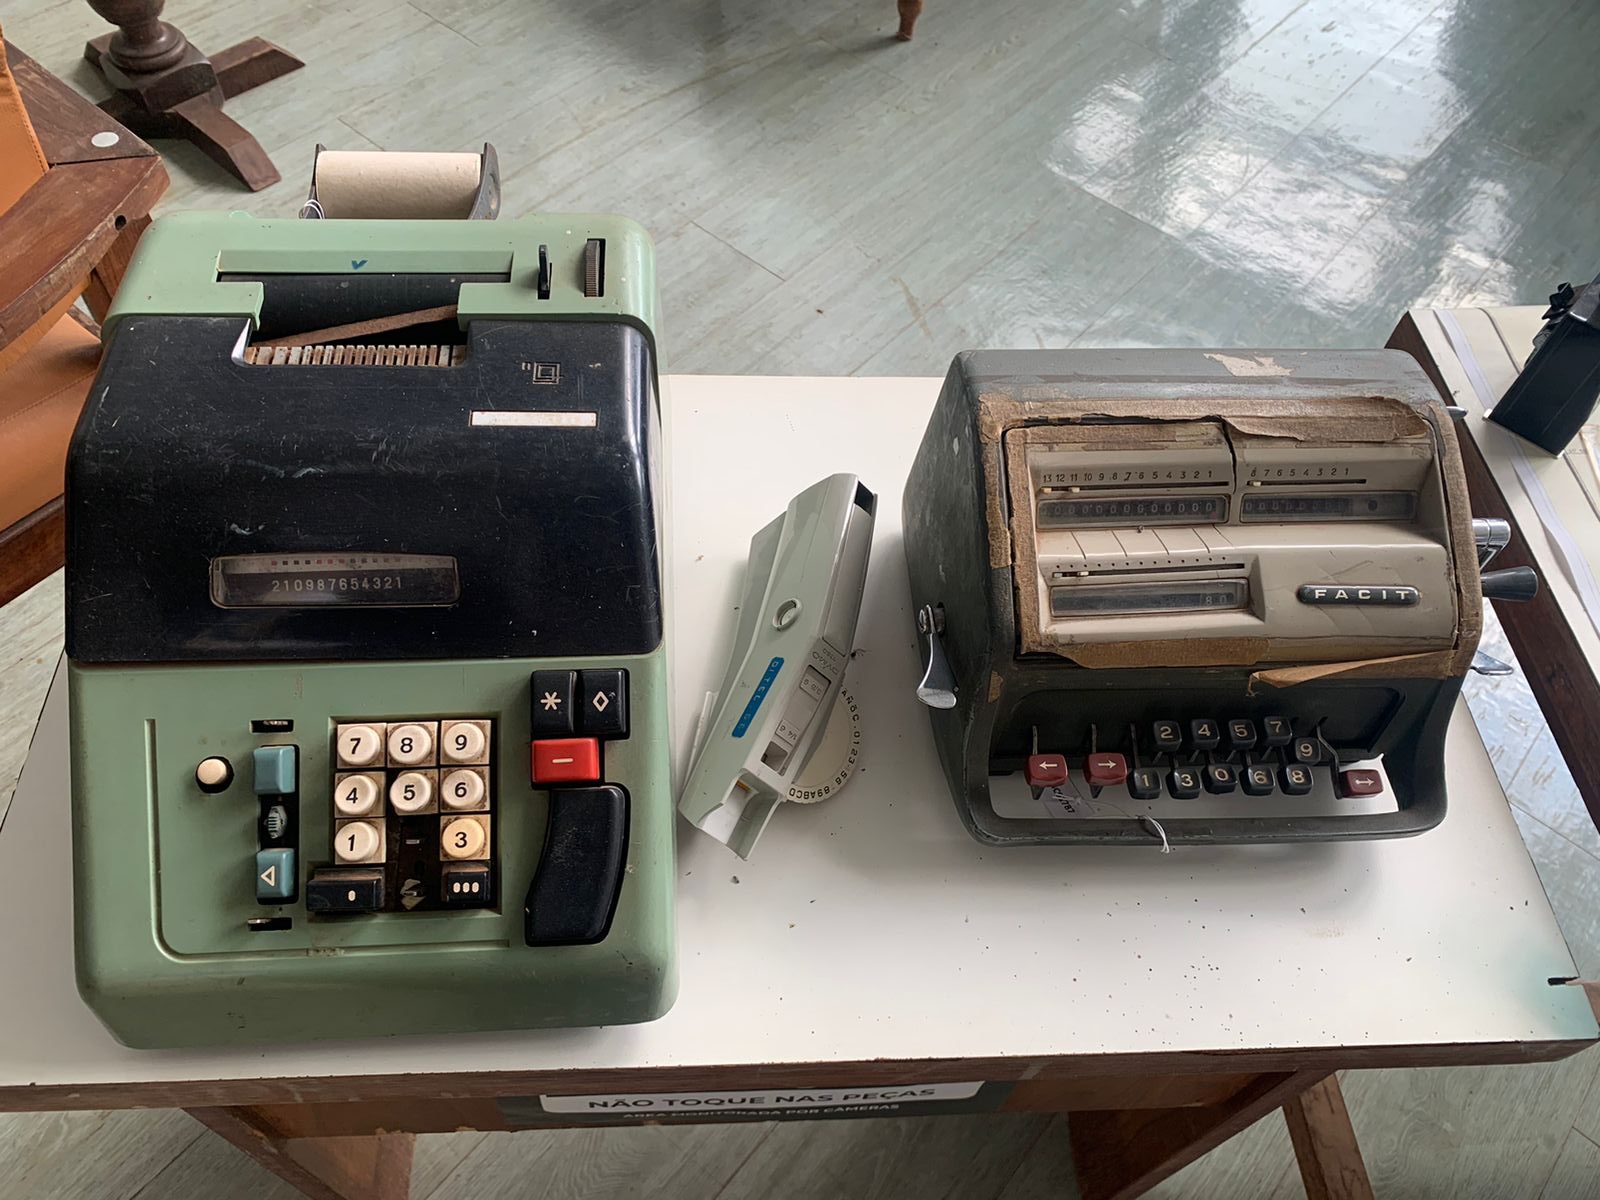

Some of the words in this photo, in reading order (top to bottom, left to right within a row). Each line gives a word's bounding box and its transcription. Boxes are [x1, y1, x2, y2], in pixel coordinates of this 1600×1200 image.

[1043, 474, 1051, 483] 13
[1056, 473, 1065, 482] 12
[1070, 473, 1078, 482] 11
[1084, 473, 1093, 481] 10
[1098, 473, 1105, 481] 9
[1112, 472, 1118, 480] 8
[1123, 472, 1131, 482] 7
[1138, 471, 1145, 480] 6
[1152, 471, 1159, 480] 5
[1166, 471, 1172, 479] 4
[1180, 471, 1186, 479] 3
[1207, 470, 1212, 478] 1
[1250, 469, 1257, 477] 8
[1263, 469, 1270, 477] 7
[1276, 469, 1283, 477] 6
[1289, 469, 1296, 477] 5
[1317, 468, 1323, 476] 3
[1330, 468, 1337, 476] 2
[1344, 467, 1349, 476] 1
[1314, 589, 1409, 600] FACIT
[350, 737, 362, 755] 7
[400, 737, 414, 753] 8
[455, 734, 468, 751] 9
[1160, 725, 1172, 739] 2
[1198, 724, 1211, 737] 4
[1233, 724, 1247, 738] 5
[1269, 721, 1282, 734] 7
[1300, 744, 1313, 757] 9
[1140, 774, 1150, 788] 1
[1181, 774, 1194, 788] 3
[1214, 768, 1228, 782] 0
[1254, 771, 1266, 784] 6
[1292, 770, 1305, 784] 8
[345, 788, 359, 804] 4
[403, 784, 416, 801] 5
[454, 782, 468, 798] 6
[347, 834, 356, 851] 1
[454, 831, 468, 848] 3
[589, 1098, 654, 1108] NÃO
[662, 1097, 765, 1106] TOQUE
[775, 1095, 833, 1103] NAS
[843, 1089, 935, 1101] PEÇAS
